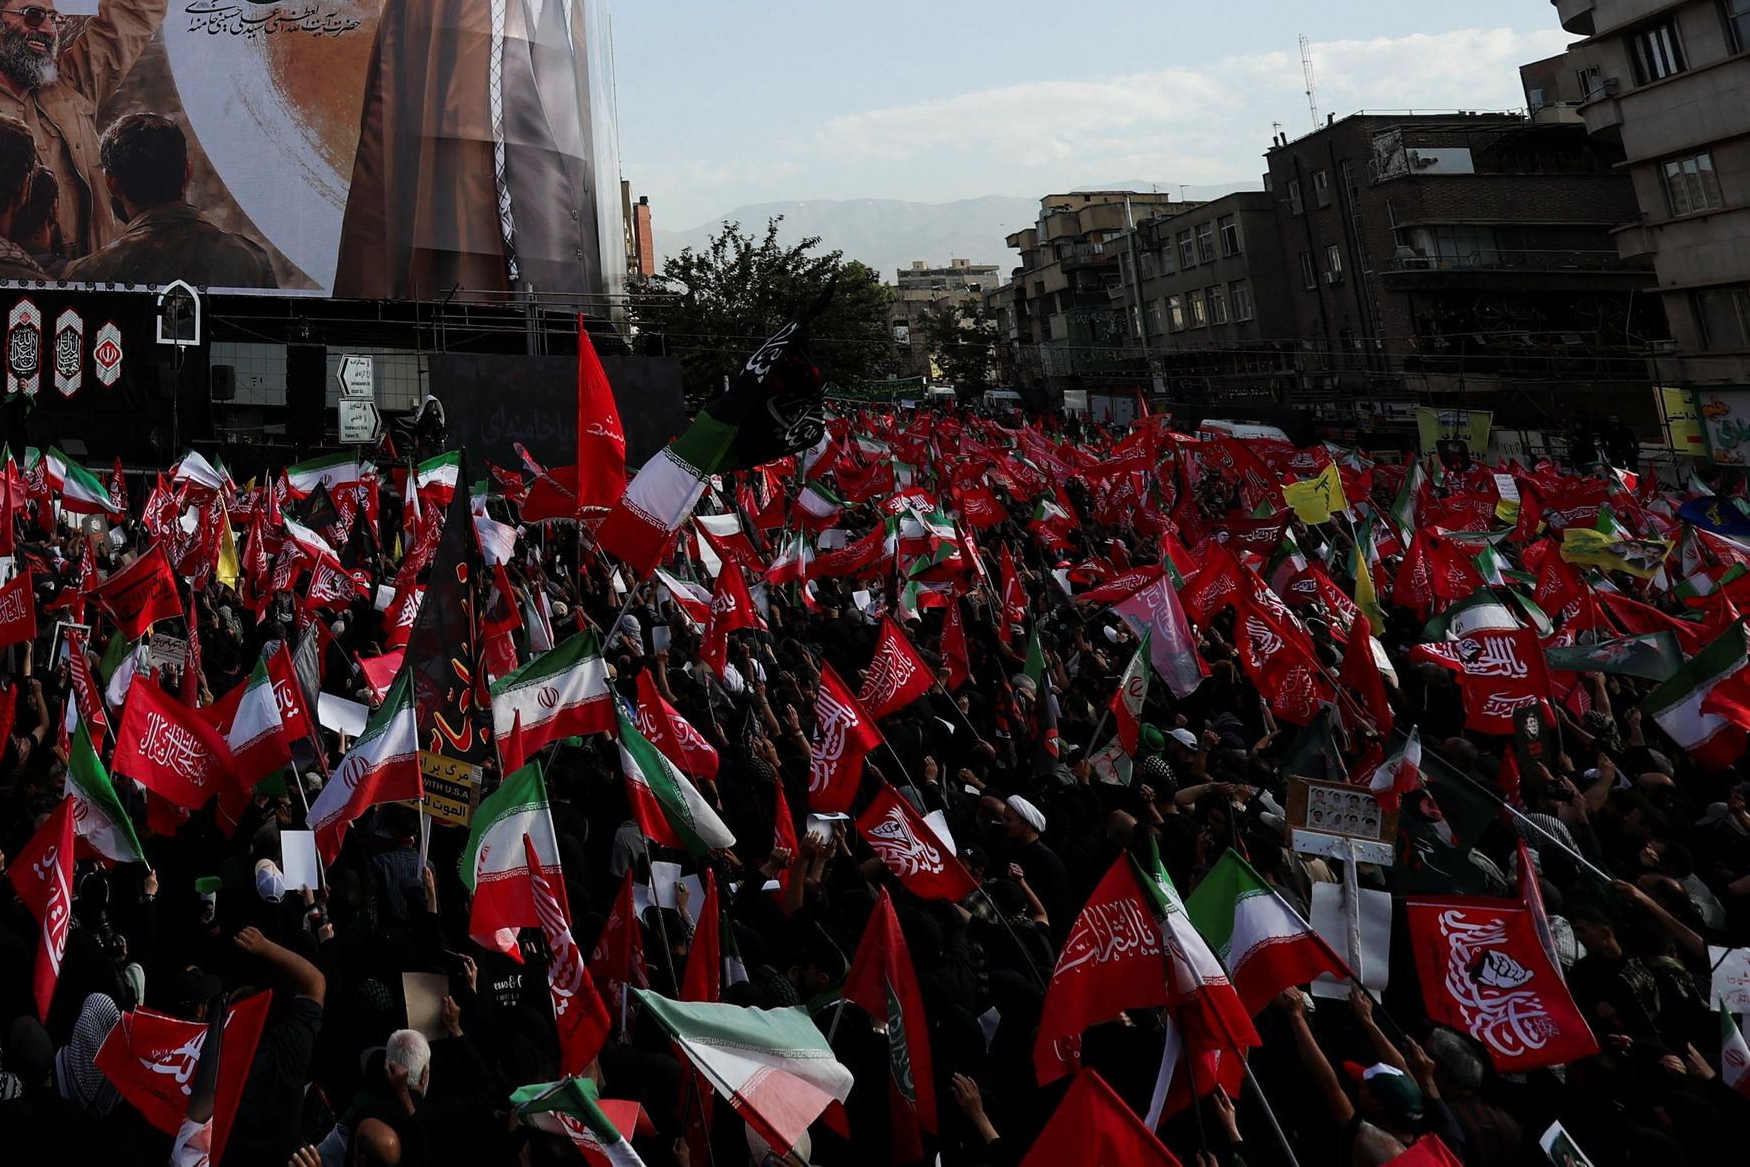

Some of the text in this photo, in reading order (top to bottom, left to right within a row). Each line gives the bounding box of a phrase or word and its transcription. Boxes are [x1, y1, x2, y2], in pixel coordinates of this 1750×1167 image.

[430, 764, 469, 782] مرگ بر
[423, 778, 469, 800] WITH U.S.A
[433, 799, 466, 818] الموت
